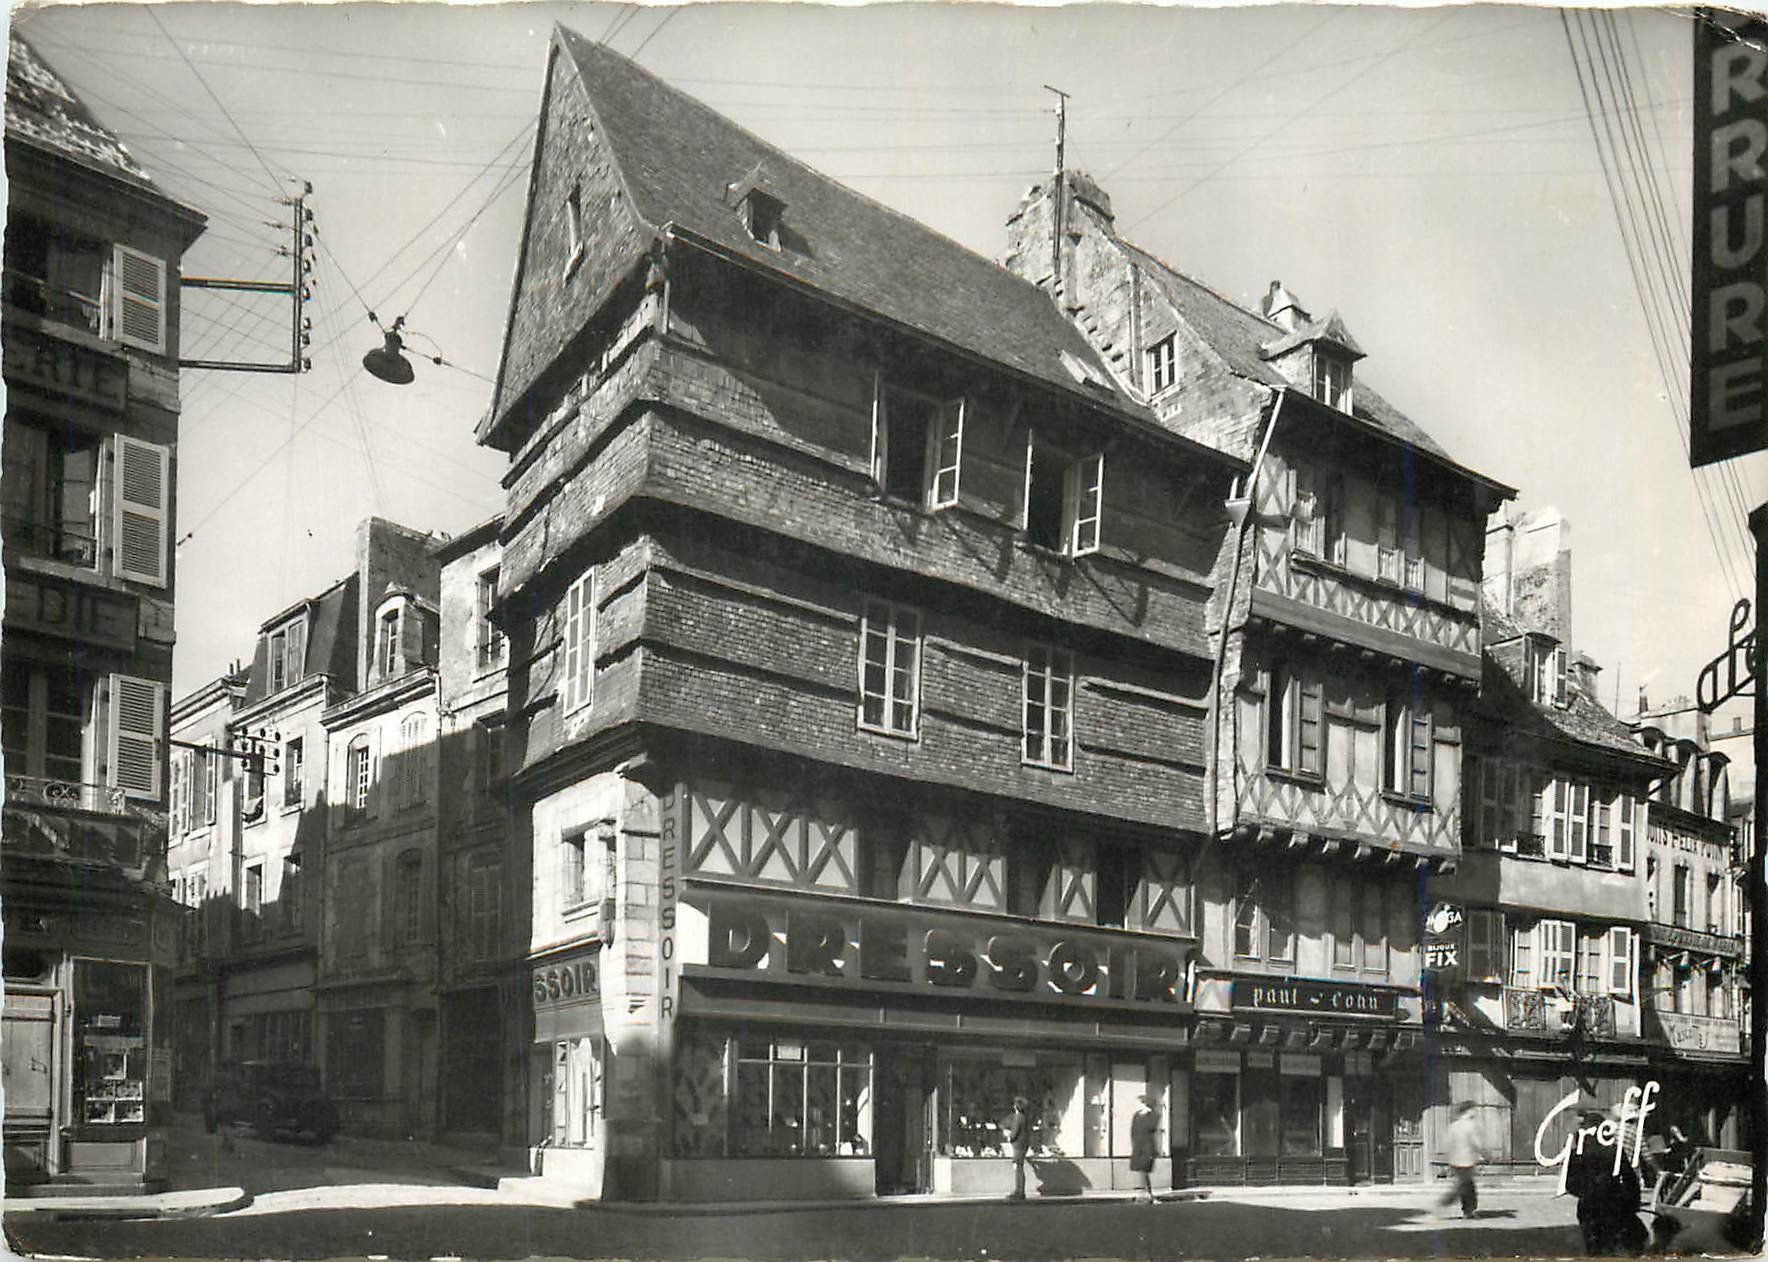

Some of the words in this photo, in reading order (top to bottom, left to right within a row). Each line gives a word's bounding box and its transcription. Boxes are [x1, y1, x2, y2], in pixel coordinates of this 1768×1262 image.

[1708, 36, 1767, 431] RRURE
[661, 789, 676, 1019] DRESSOIR
[709, 902, 1180, 1001] DRESSOIR
[1425, 951, 1459, 968] FIX
